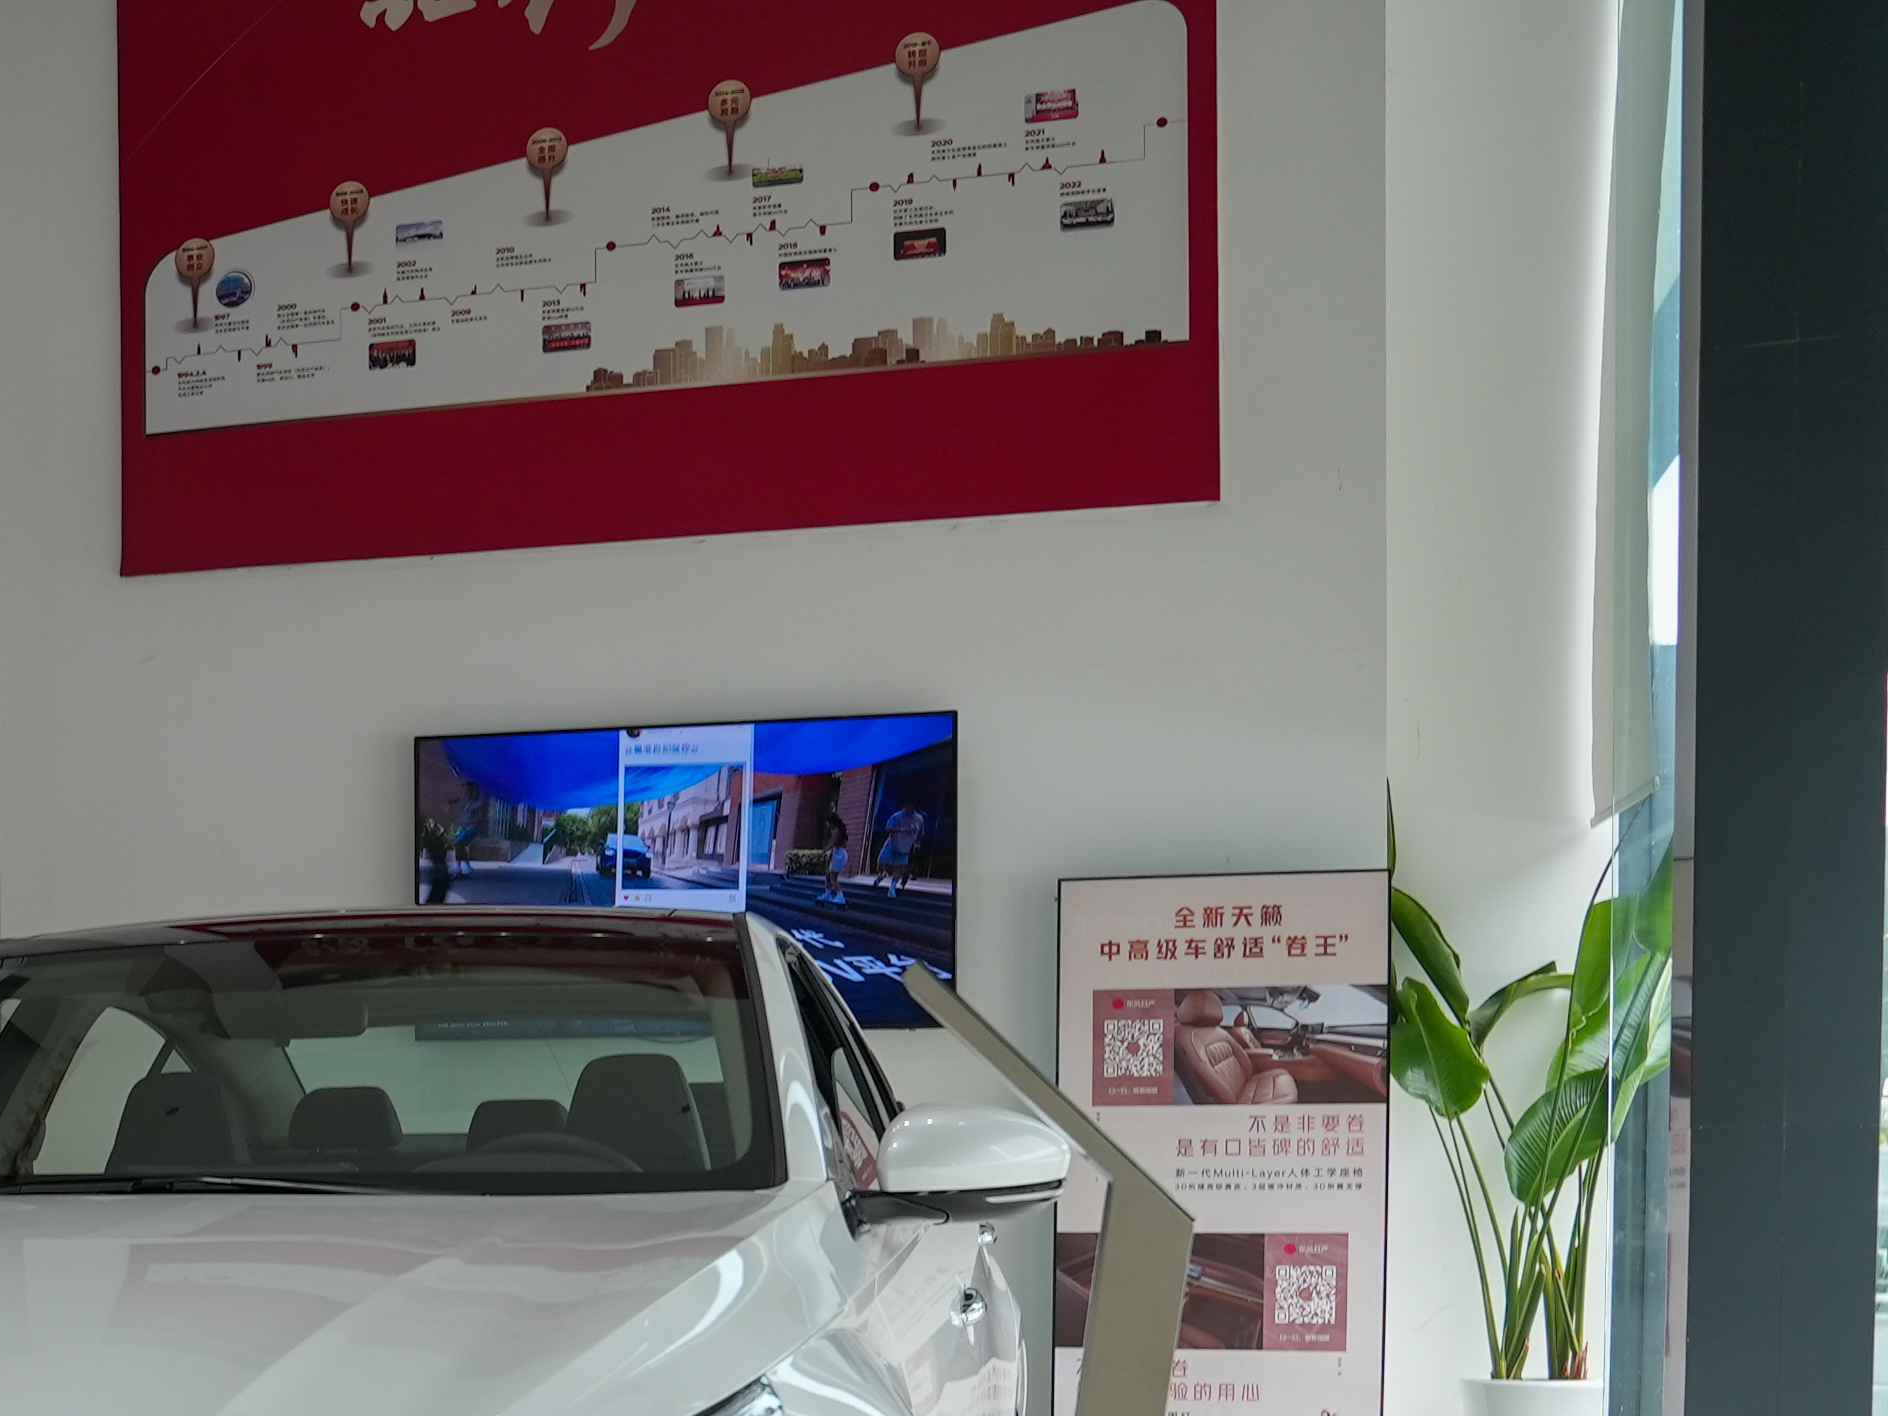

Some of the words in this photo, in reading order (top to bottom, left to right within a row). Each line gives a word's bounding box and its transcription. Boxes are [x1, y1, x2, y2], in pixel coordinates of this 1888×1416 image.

[1024, 128, 1045, 137] 2021
[930, 138, 953, 148] 2020
[1059, 181, 1082, 190] 2022
[752, 195, 772, 204] 2017
[893, 198, 914, 207] 2019
[651, 205, 671, 215] 2014
[495, 246, 515, 255] 2010
[778, 242, 798, 251] 2018
[674, 252, 694, 262] 2016
[541, 299, 561, 308] 2013
[367, 316, 386, 326] 2001
[1173, 903, 1283, 929] 全新天籁
[1099, 933, 1350, 962] 中高级车舒适“卷王”
[1248, 1113, 1365, 1134] 不是非要卷
[1176, 1137, 1365, 1158] 是有口皆碑的舒适
[1169, 1382, 1260, 1402] 验的用心
